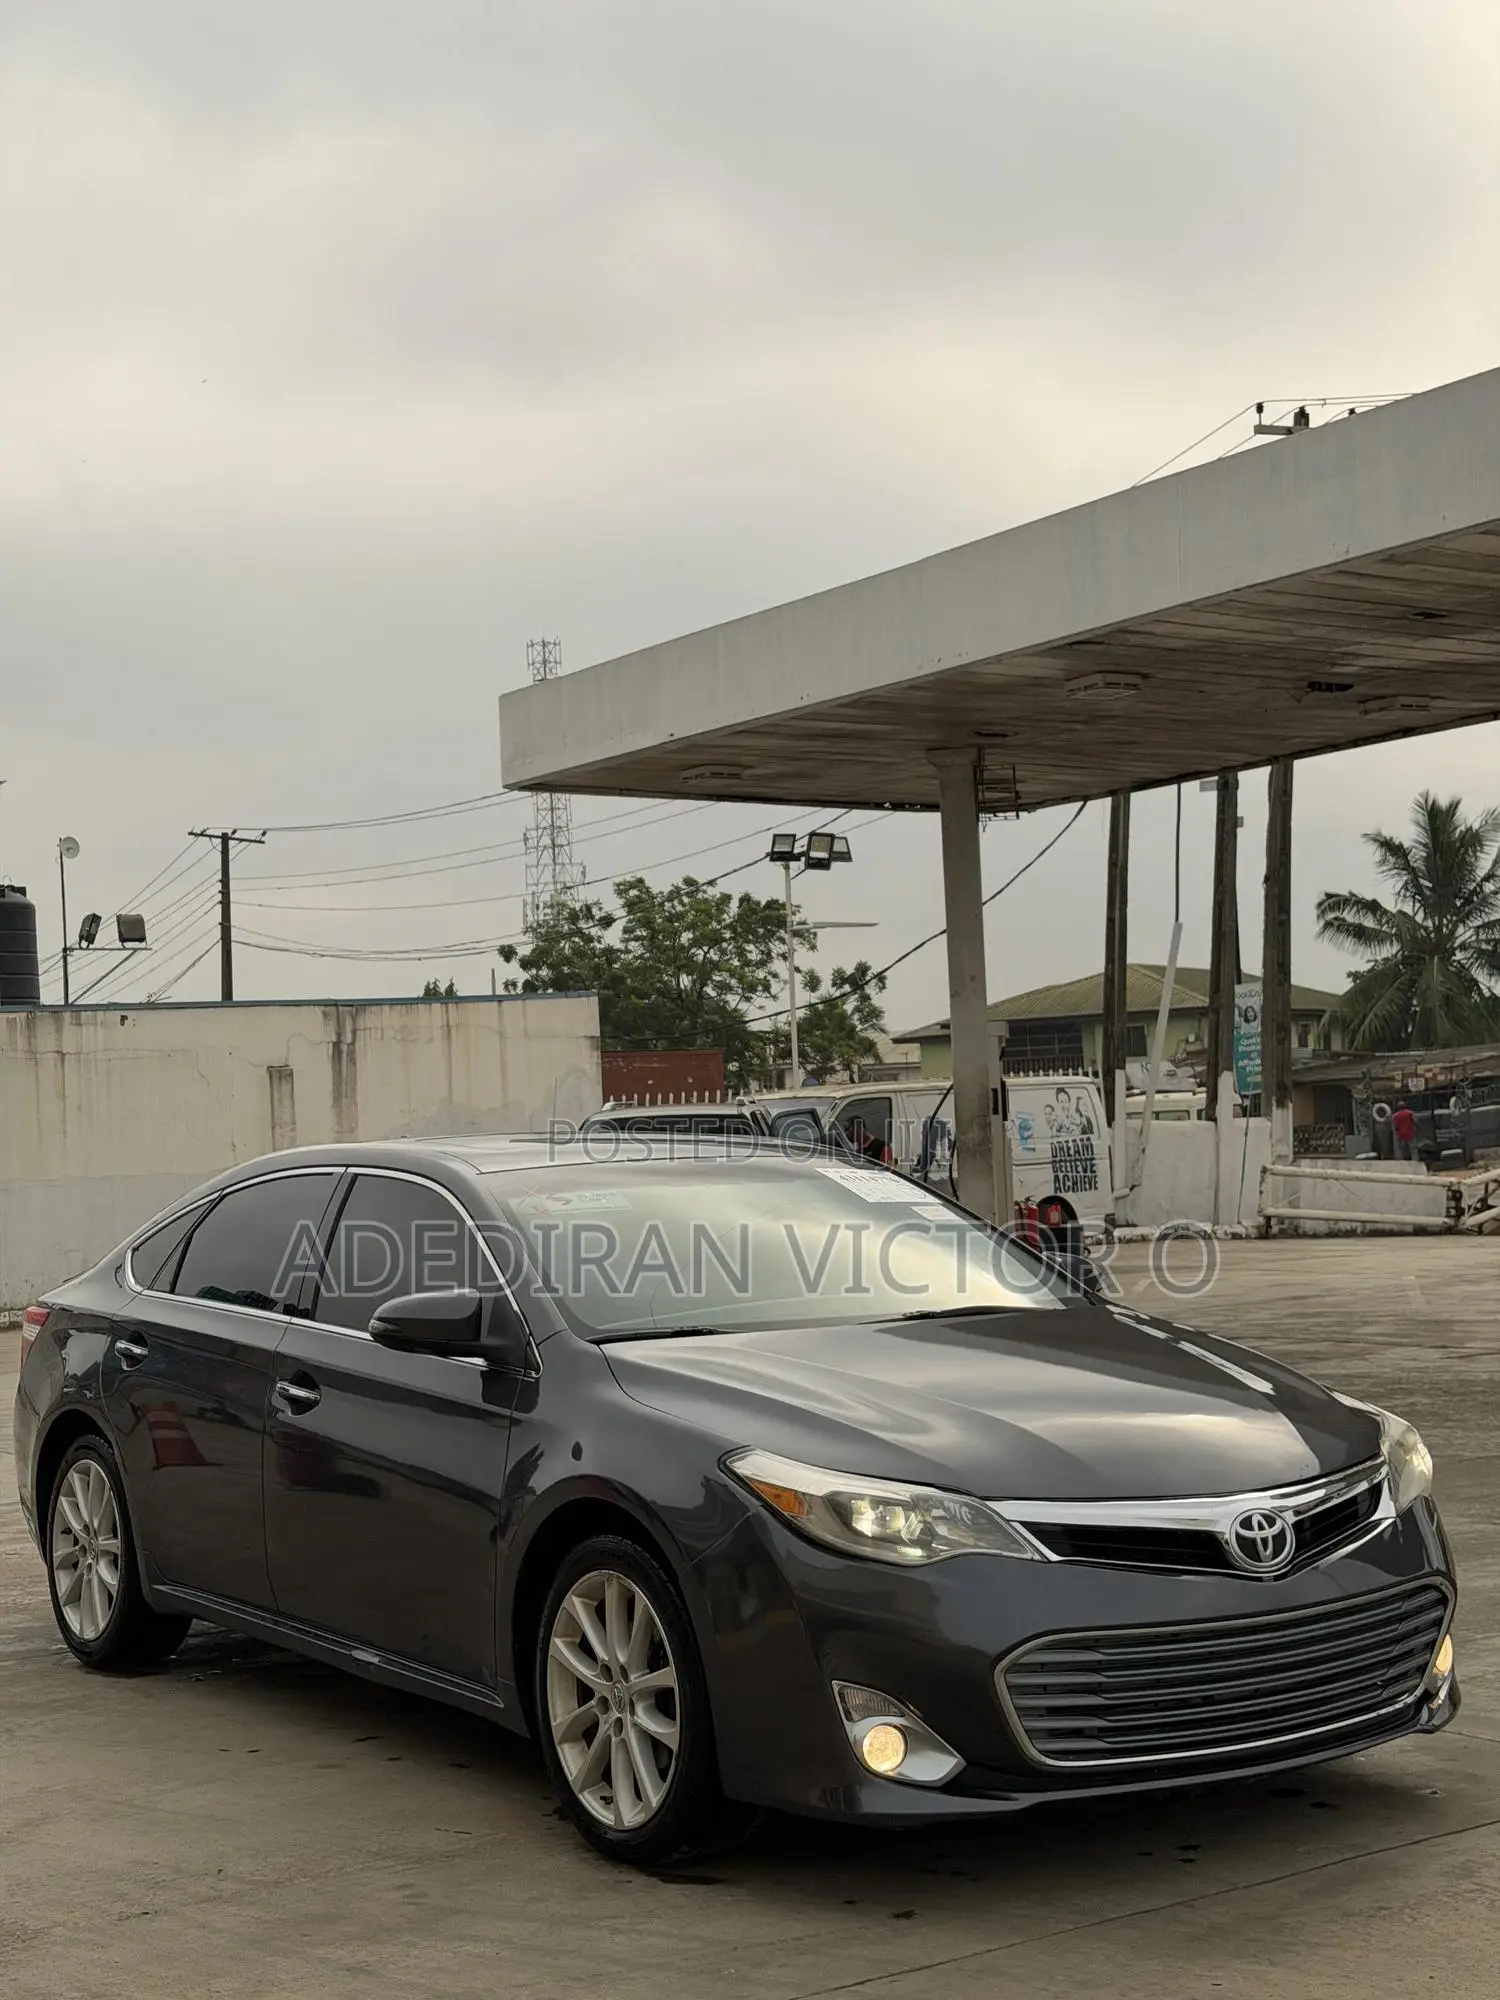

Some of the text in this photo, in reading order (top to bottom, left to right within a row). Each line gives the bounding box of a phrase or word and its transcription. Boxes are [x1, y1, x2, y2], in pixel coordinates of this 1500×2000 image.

[1050, 1136, 1095, 1158] DREAM
[1051, 1157, 1097, 1175] BELIEVE
[1053, 1174, 1098, 1194] ACHIEVE
